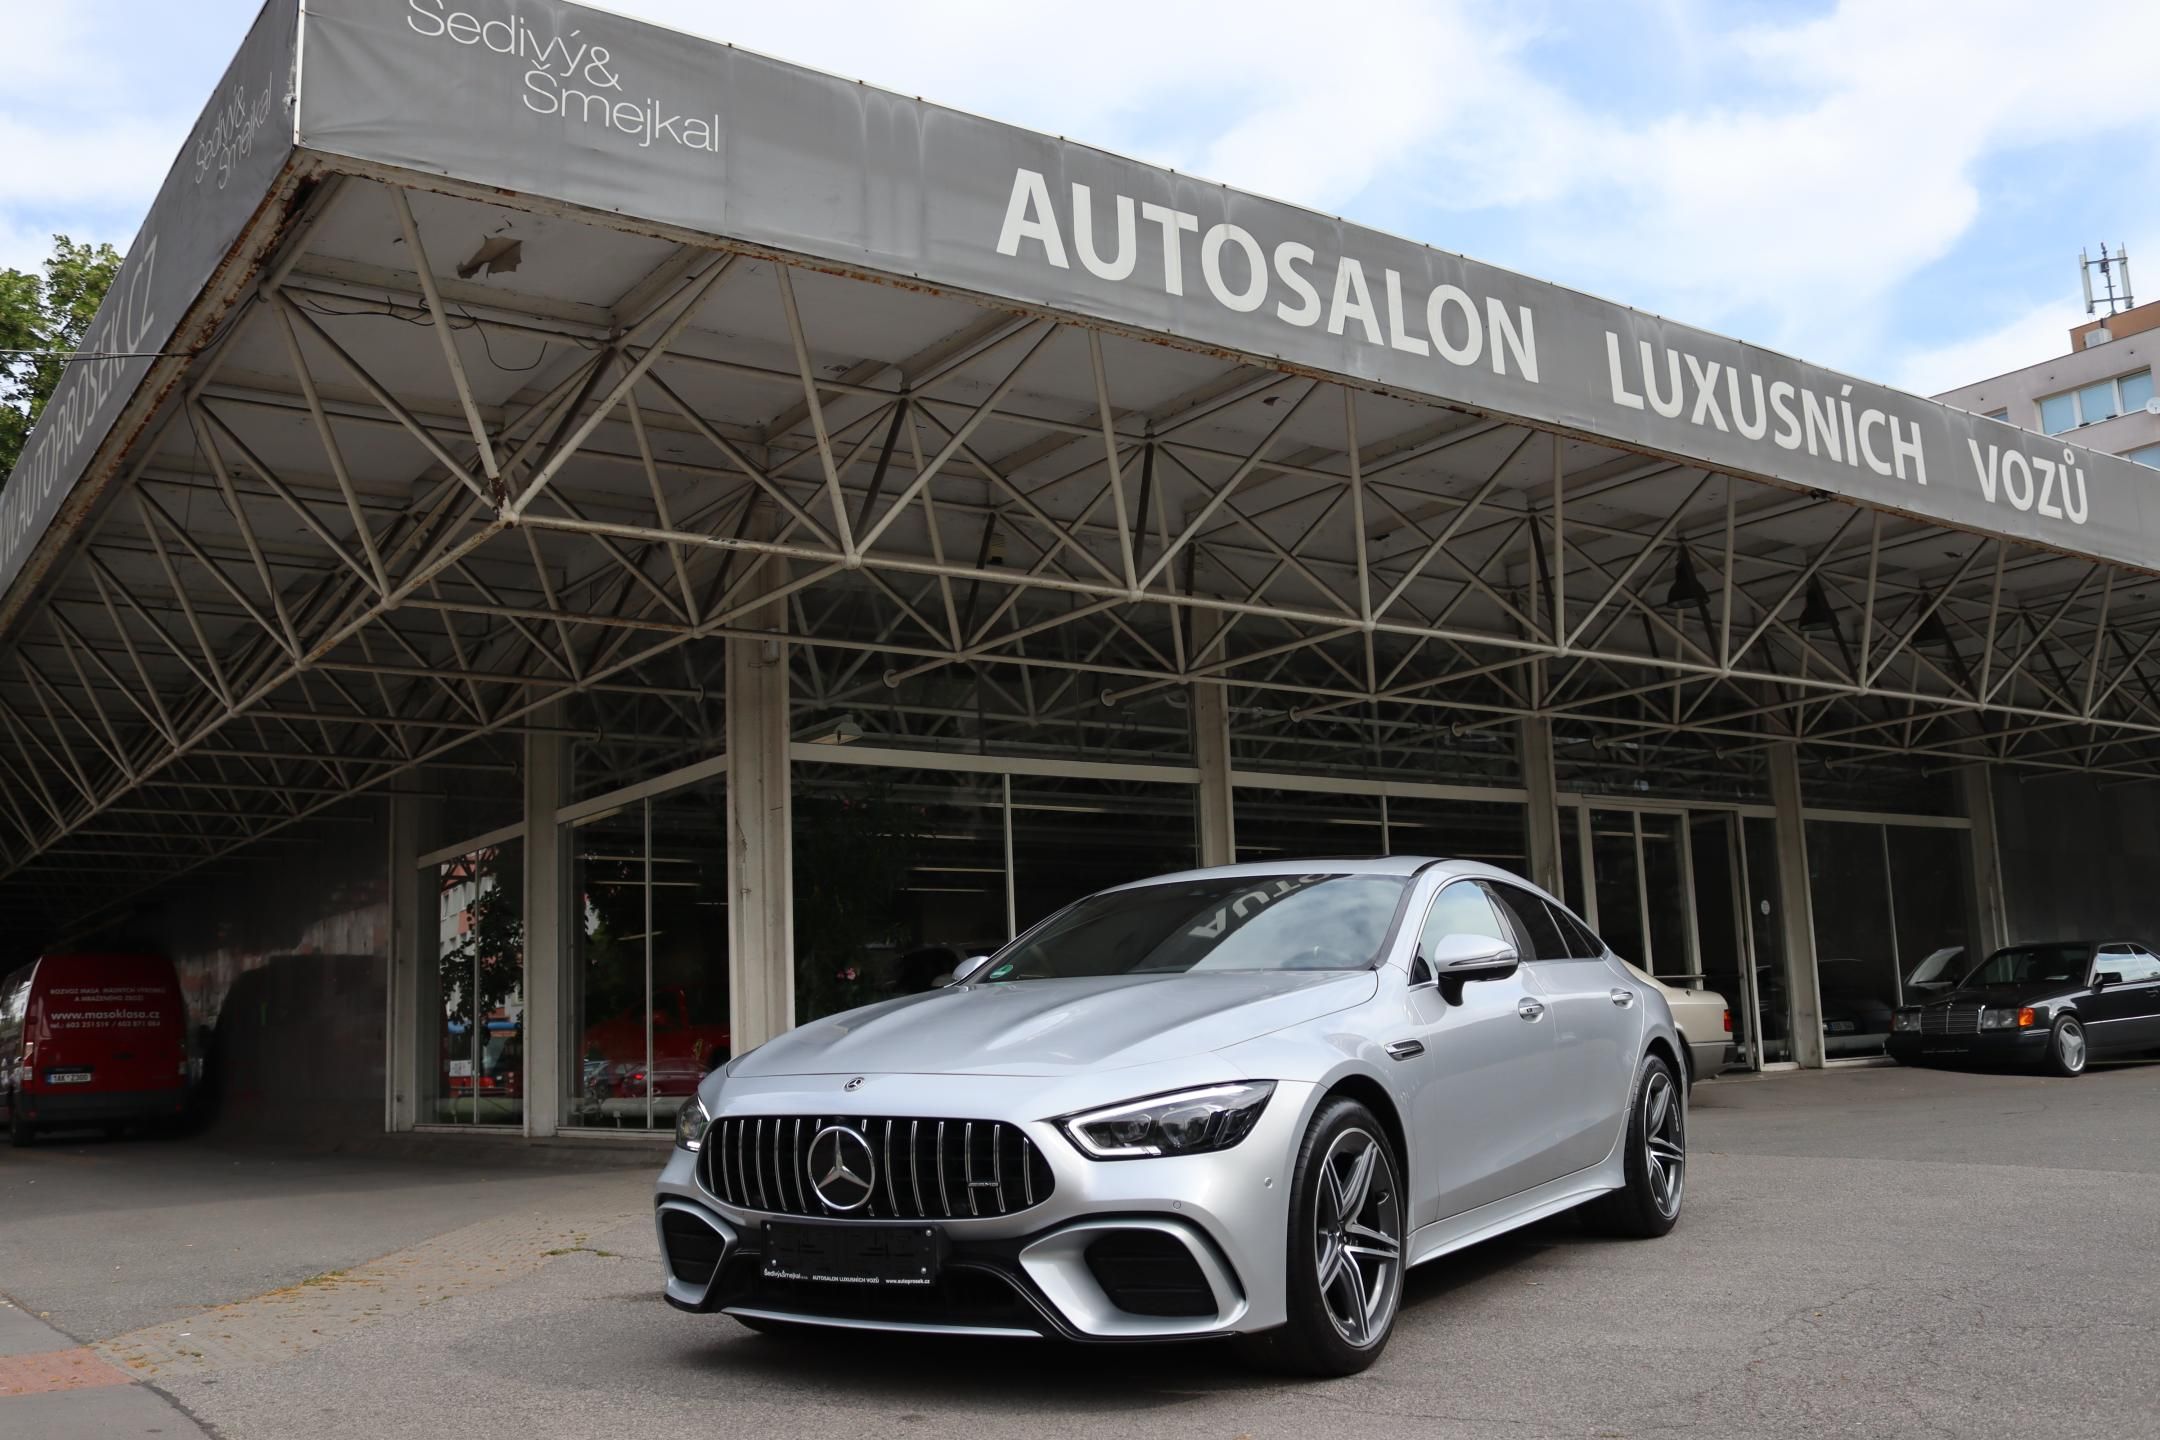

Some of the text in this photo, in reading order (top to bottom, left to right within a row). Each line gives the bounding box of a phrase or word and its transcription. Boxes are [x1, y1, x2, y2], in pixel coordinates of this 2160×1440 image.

[522, 59, 719, 153] Šmejkal
[996, 167, 2089, 525] AUTOSALON LUXUSNÍCH VOZŮ
[51, 1009, 160, 1021] www.masoklasa.cz
